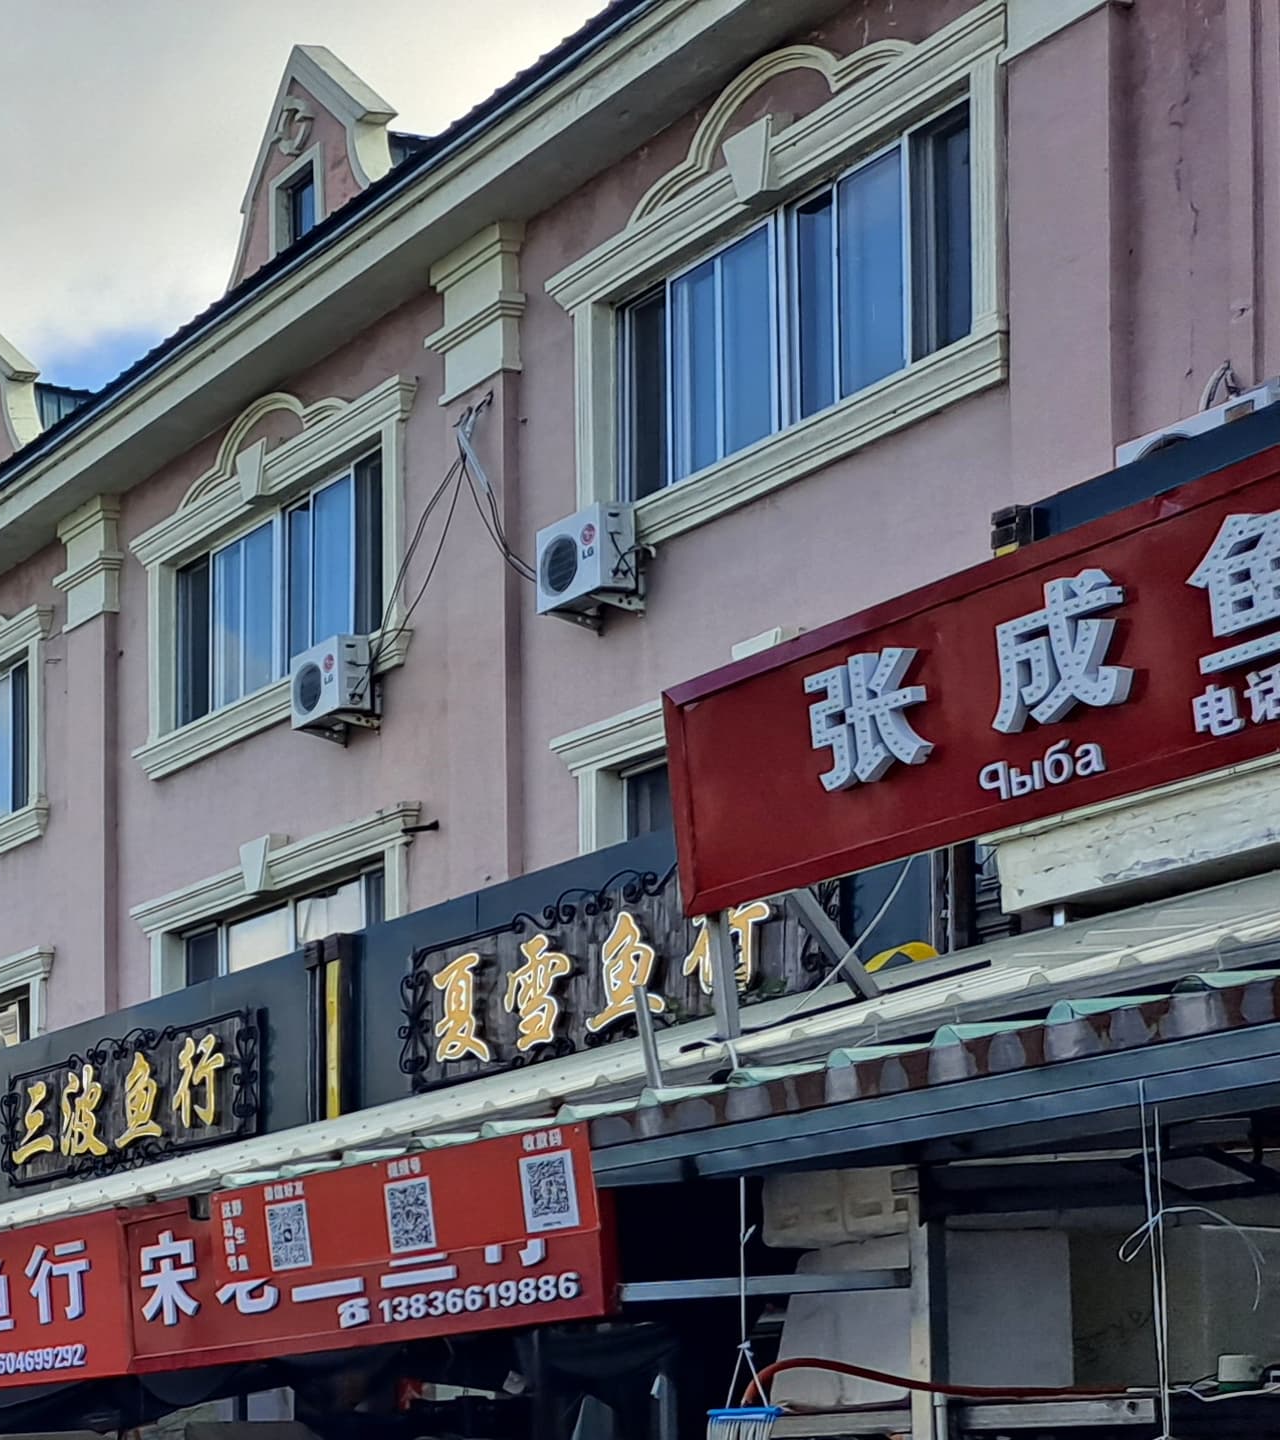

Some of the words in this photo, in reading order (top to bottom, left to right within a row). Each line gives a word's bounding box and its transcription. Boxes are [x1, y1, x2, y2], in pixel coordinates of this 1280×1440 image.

[582, 546, 595, 560] LG
[323, 673, 335, 685] LG
[12, 1032, 226, 1165] 三波鱼行
[378, 1272, 580, 1323] 13836619886
